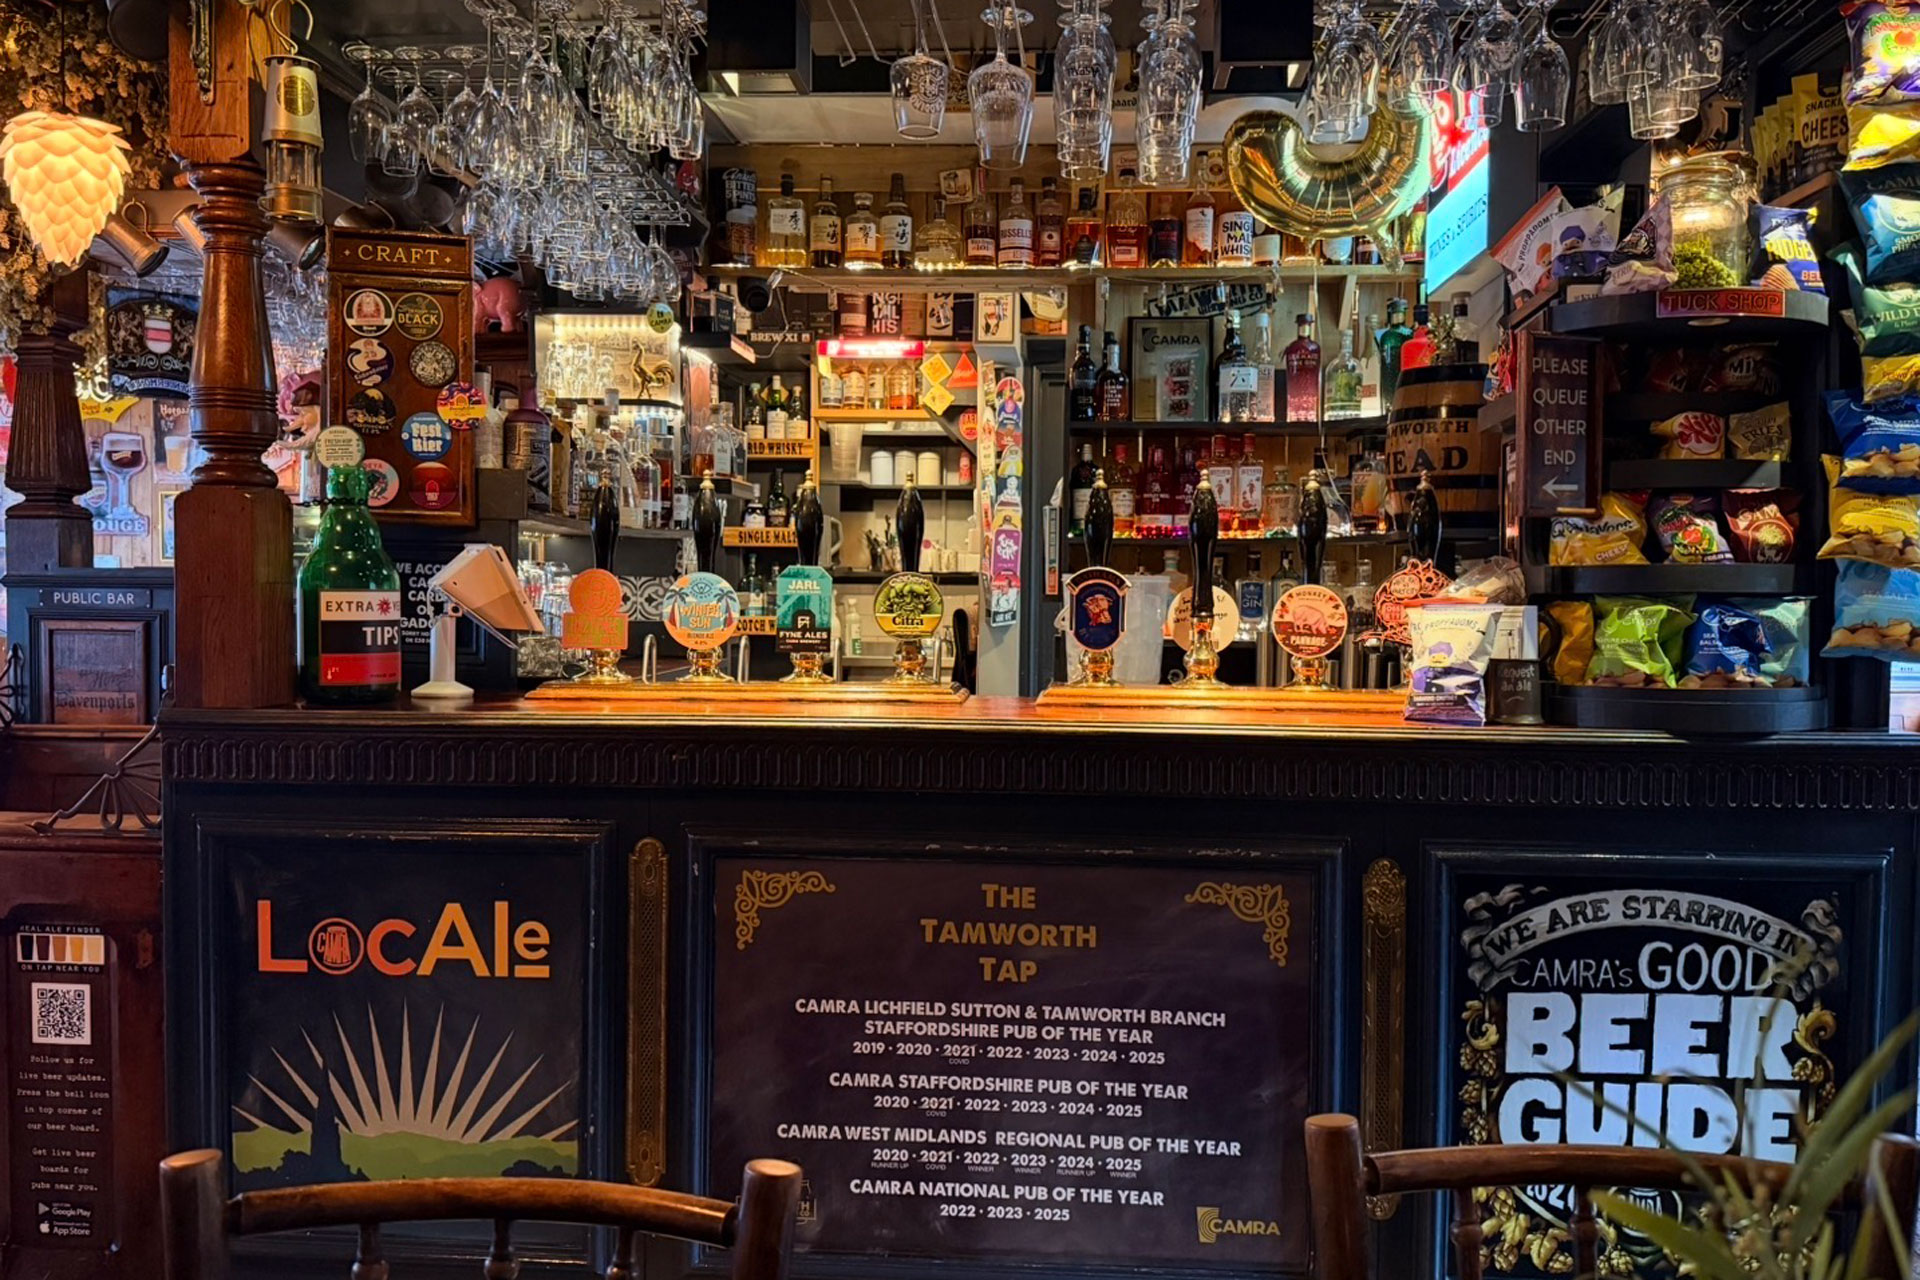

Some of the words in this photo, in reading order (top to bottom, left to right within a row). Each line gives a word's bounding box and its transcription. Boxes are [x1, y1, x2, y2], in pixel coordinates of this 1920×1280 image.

[1801, 115, 1849, 144] CHEES
[1222, 221, 1250, 232] SING
[1226, 232, 1251, 244] MAL
[357, 244, 440, 266] CRAFT
[1221, 244, 1250, 255] WHIS
[1664, 294, 1720, 311] TUCK
[1725, 293, 1780, 311] SHOP
[397, 313, 438, 325] BLACK
[750, 333, 780, 343] BREW
[784, 333, 798, 343] XI
[1151, 335, 1201, 346] CAMRA
[1532, 357, 1589, 376] PLEASE
[1533, 387, 1588, 407] QUEUE
[1534, 419, 1587, 436] OTHER
[1741, 423, 1783, 442] FRIES
[767, 442, 804, 455] WHISKY
[1544, 450, 1576, 466] END
[93, 519, 144, 532] OUGE
[738, 531, 772, 544] SINGLE
[788, 579, 820, 590] JARL
[53, 591, 102, 605] PUBLIC
[107, 592, 135, 605] BAR
[325, 600, 374, 613] EXTRA
[736, 619, 766, 632] COTCH
[892, 615, 924, 626] Citra
[362, 626, 399, 646] TIPS
[779, 631, 803, 639] FYNE
[804, 631, 828, 639] ALES
[1503, 665, 1535, 682] equest
[56, 691, 135, 713] Davenports
[982, 883, 1036, 910] THE
[66, 926, 101, 934] FINDER
[921, 918, 1097, 948] TAMWORTH
[1486, 917, 1538, 957] WE
[1545, 897, 1612, 932] ARE
[1621, 895, 1769, 942] STARRING
[1778, 929, 1808, 959] IN
[257, 899, 551, 979] LocAle
[979, 957, 1038, 983] TAP
[1509, 956, 1634, 989] CAMRA's
[1637, 941, 1778, 993] GOOD
[795, 998, 861, 1014] CAMRA
[864, 1000, 947, 1016] LICHFIELD
[951, 1002, 1020, 1019] SUTTON
[1024, 1005, 1038, 1020] &
[1042, 1005, 1147, 1024] TAMWORTH
[1150, 1010, 1226, 1028] BRANCH
[864, 1019, 999, 1038] STAFFORDSHIRE
[1003, 1024, 1038, 1040] PUB
[1041, 1025, 1065, 1041] OF
[1069, 1027, 1102, 1042] THE
[1106, 1028, 1154, 1044] YEAR
[1505, 992, 1802, 1082] BEER
[30, 1054, 60, 1064] Follow
[79, 1056, 95, 1065] for
[853, 1041, 886, 1054] 2019
[896, 1043, 932, 1056] 2020
[942, 1044, 977, 1058] 2021
[986, 1045, 1023, 1059] 2022
[1033, 1047, 1070, 1061] 2023
[1081, 1049, 1118, 1063] 2024
[1129, 1050, 1166, 1064] 2025
[948, 1057, 970, 1065] COVID
[19, 1071, 39, 1080] live
[42, 1072, 63, 1080] beer
[17, 1088, 41, 1096] Press
[45, 1089, 61, 1097] the
[829, 1072, 895, 1088] CAMRA
[898, 1074, 1034, 1093] STAFFORDSHIRE
[1037, 1079, 1073, 1095] PUB
[1076, 1080, 1100, 1096] OF
[1104, 1082, 1137, 1097] THE
[1141, 1083, 1189, 1100] YEAR
[24, 1105, 35, 1113] in
[38, 1106, 54, 1115] top
[57, 1107, 88, 1115] corner
[91, 1107, 103, 1116] of
[873, 1095, 909, 1108] 2020
[920, 1096, 954, 1110] 2021
[964, 1098, 1000, 1112] 2022
[1011, 1100, 1048, 1114] 2023
[1058, 1102, 1095, 1116] 2024
[1106, 1103, 1143, 1118] 2025
[925, 1110, 947, 1118] COVID
[46, 1122, 66, 1131] beer
[1499, 1078, 1802, 1165] GUIDE
[777, 1123, 842, 1140] CAMRA
[844, 1126, 891, 1142] WEST
[894, 1127, 987, 1145] MIDLANDS
[995, 1131, 1086, 1149] REGIONAL
[1089, 1134, 1125, 1151] PUB
[1128, 1136, 1153, 1152] OF
[1156, 1138, 1189, 1154] THE
[1193, 1140, 1242, 1157] YEAR
[32, 1147, 48, 1156] Get
[52, 1148, 72, 1157] live
[76, 1149, 97, 1158] beer
[873, 1148, 909, 1162] 2020
[919, 1149, 953, 1163] 2021
[963, 1151, 1000, 1165] 2022
[1010, 1154, 1047, 1168] 2023
[1057, 1155, 1095, 1169] 2024
[1105, 1157, 1142, 1171] 2025
[73, 1166, 89, 1174] for
[925, 1163, 947, 1171] COVID
[967, 1165, 995, 1173] WINNER
[1013, 1167, 1041, 1175] WINNER
[1109, 1171, 1137, 1179] WINNER
[850, 1179, 915, 1196] CAMRA
[919, 1181, 1010, 1199] NATIONAL
[1014, 1184, 1049, 1201] PUB
[1052, 1187, 1076, 1202] OF
[1080, 1188, 1113, 1204] THE
[1117, 1190, 1165, 1206] YEAR
[51, 1207, 76, 1218] Google
[76, 1208, 92, 1218] Play
[940, 1203, 976, 1218] 2022
[986, 1205, 1023, 1220] 2023
[1034, 1207, 1071, 1222] 2025
[53, 1226, 69, 1236] App
[69, 1227, 91, 1236] Store
[1210, 1217, 1281, 1236] CAMRA
